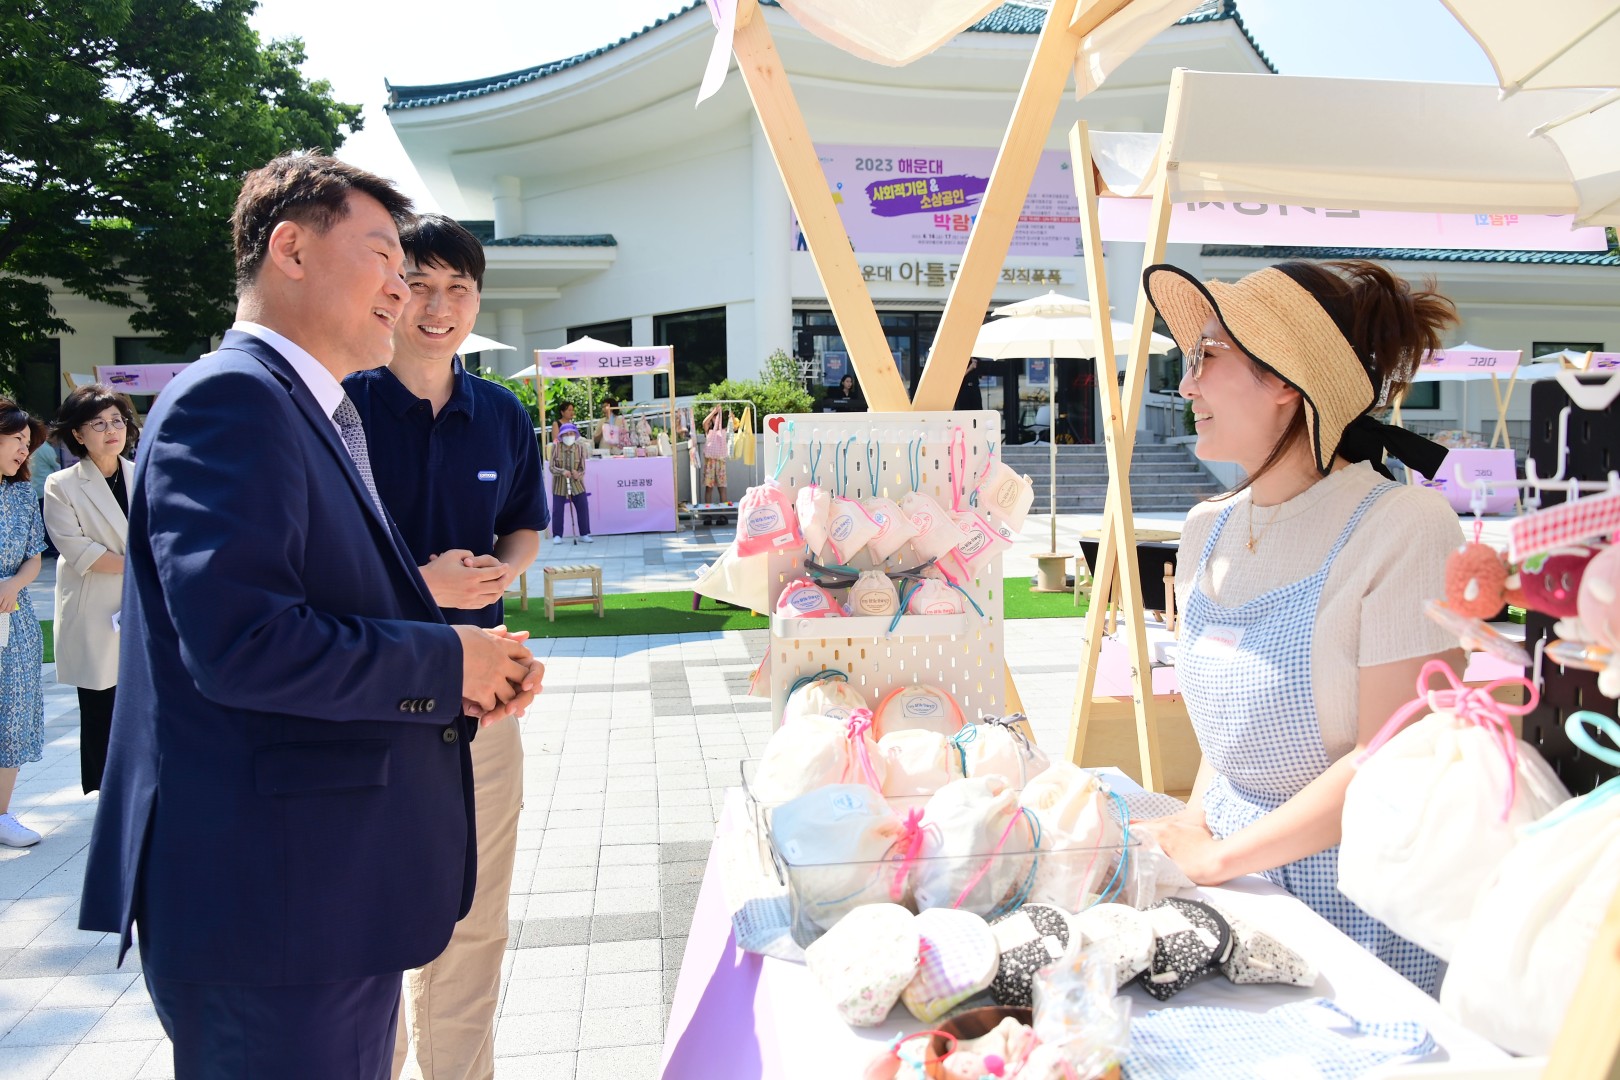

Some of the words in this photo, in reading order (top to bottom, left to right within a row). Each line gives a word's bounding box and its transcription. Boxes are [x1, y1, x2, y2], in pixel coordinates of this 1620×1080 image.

[855, 158, 893, 171] 2023
[898, 158, 943, 174] 해운대
[872, 180, 928, 201] 사회적기업
[929, 178, 939, 192] &
[920, 189, 965, 209] 소상공인
[934, 213, 977, 232] 박람
[858, 265, 891, 282] 운대
[598, 355, 656, 368] 오나르공방
[616, 478, 653, 488] 오나르공방
